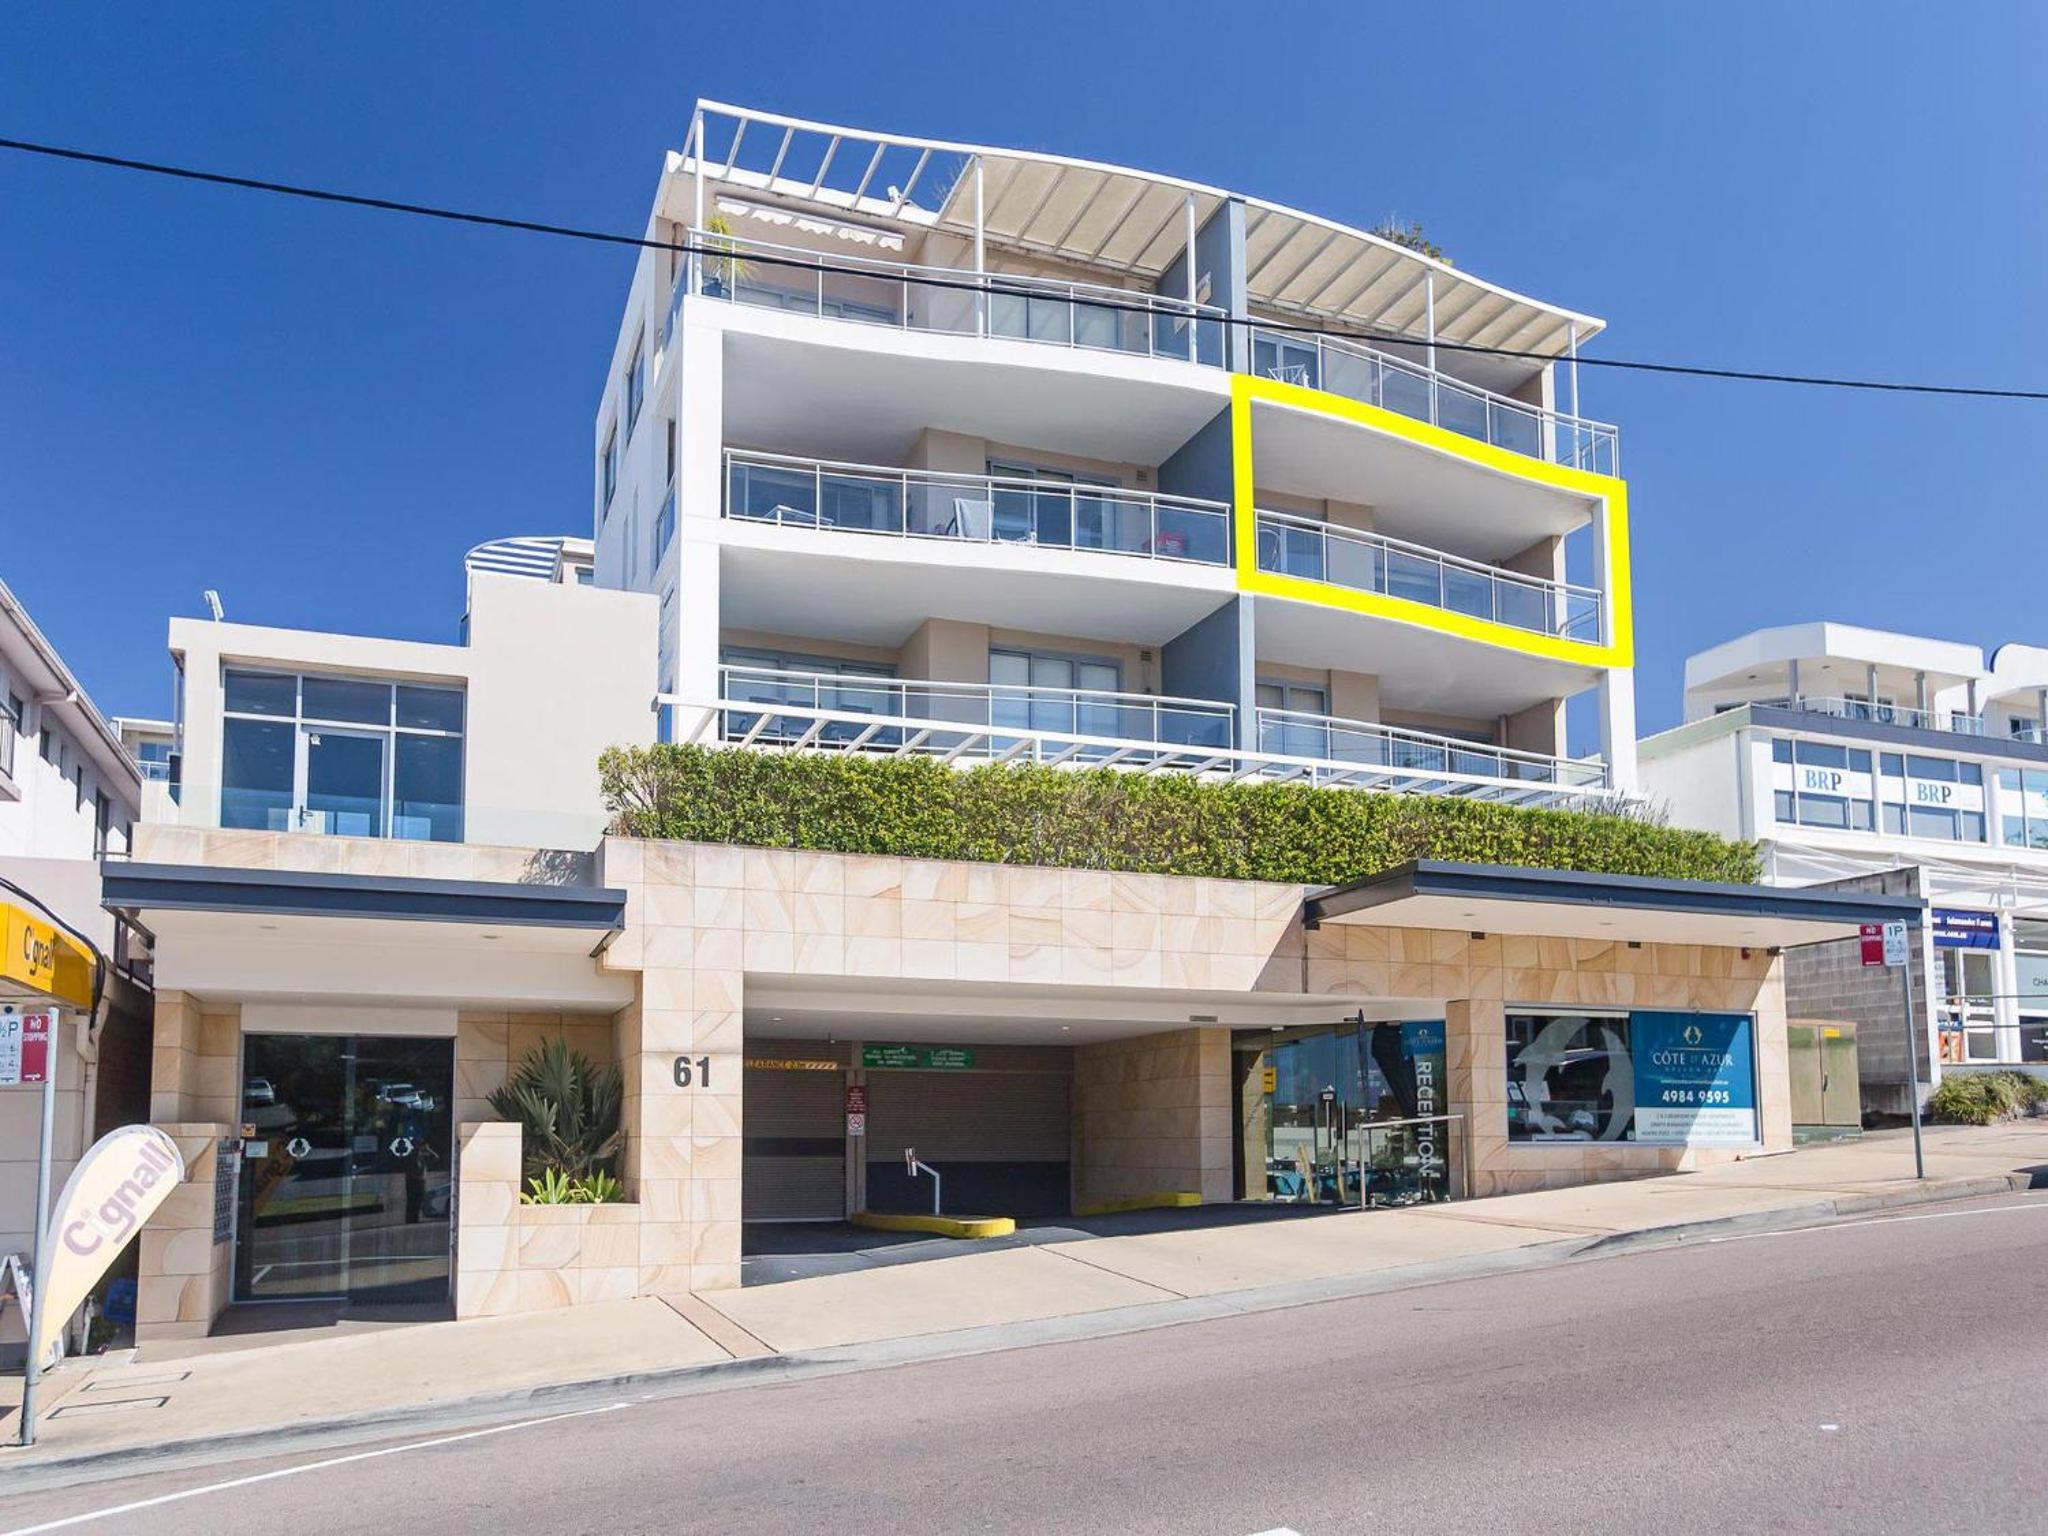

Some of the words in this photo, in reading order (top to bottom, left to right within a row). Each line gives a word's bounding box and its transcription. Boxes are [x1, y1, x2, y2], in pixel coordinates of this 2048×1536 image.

[1805, 769, 1842, 792] BRP
[1917, 783, 1952, 804] BRP
[1888, 926, 1903, 936] 1P
[673, 1056, 710, 1088] 61
[1662, 1090, 1694, 1103] 4984
[1698, 1090, 1730, 1104] 9595
[63, 1139, 174, 1256] Cignall
